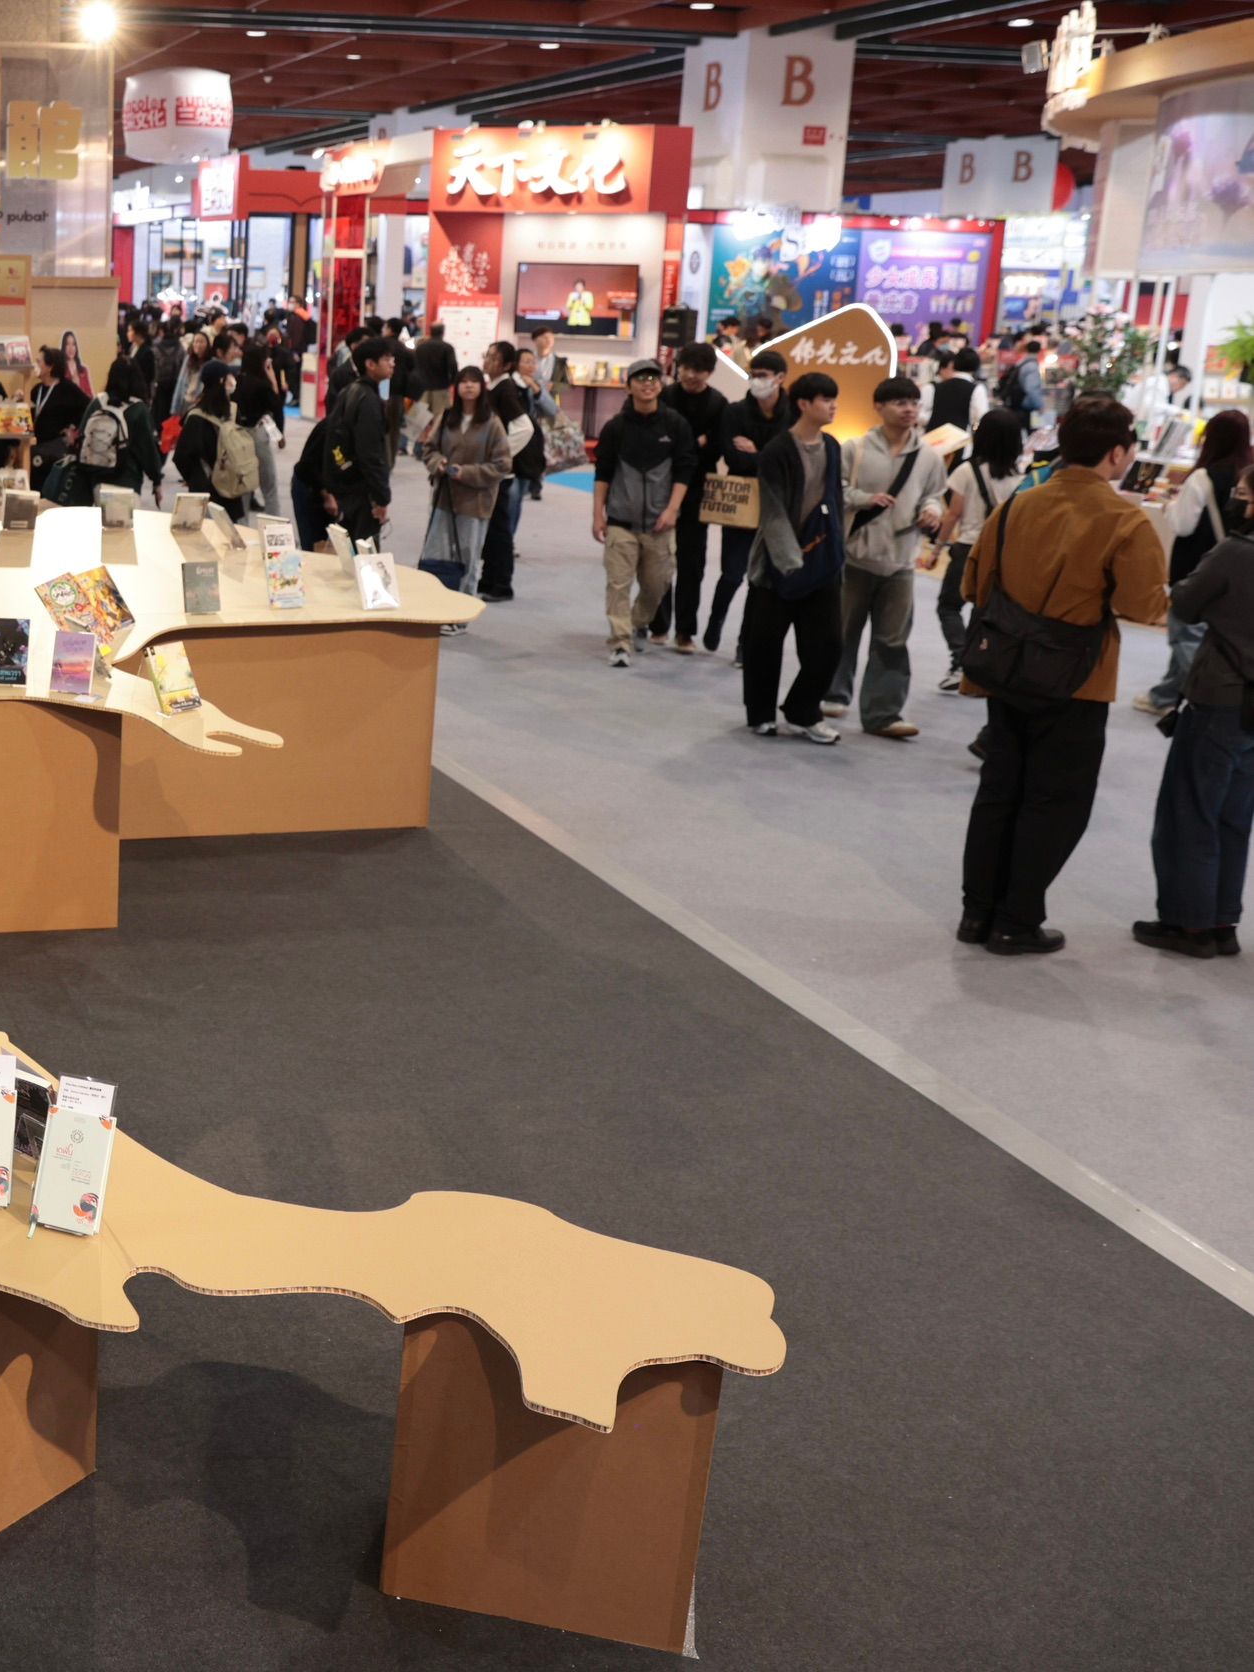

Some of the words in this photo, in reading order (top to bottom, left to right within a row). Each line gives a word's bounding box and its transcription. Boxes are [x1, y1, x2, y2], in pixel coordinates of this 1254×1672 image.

[703, 61, 723, 112] B
[781, 56, 816, 106] B
[446, 142, 626, 196] 天下文化
[959, 152, 975, 184] B
[1013, 150, 1034, 182] B
[789, 336, 889, 366] 佛光文化
